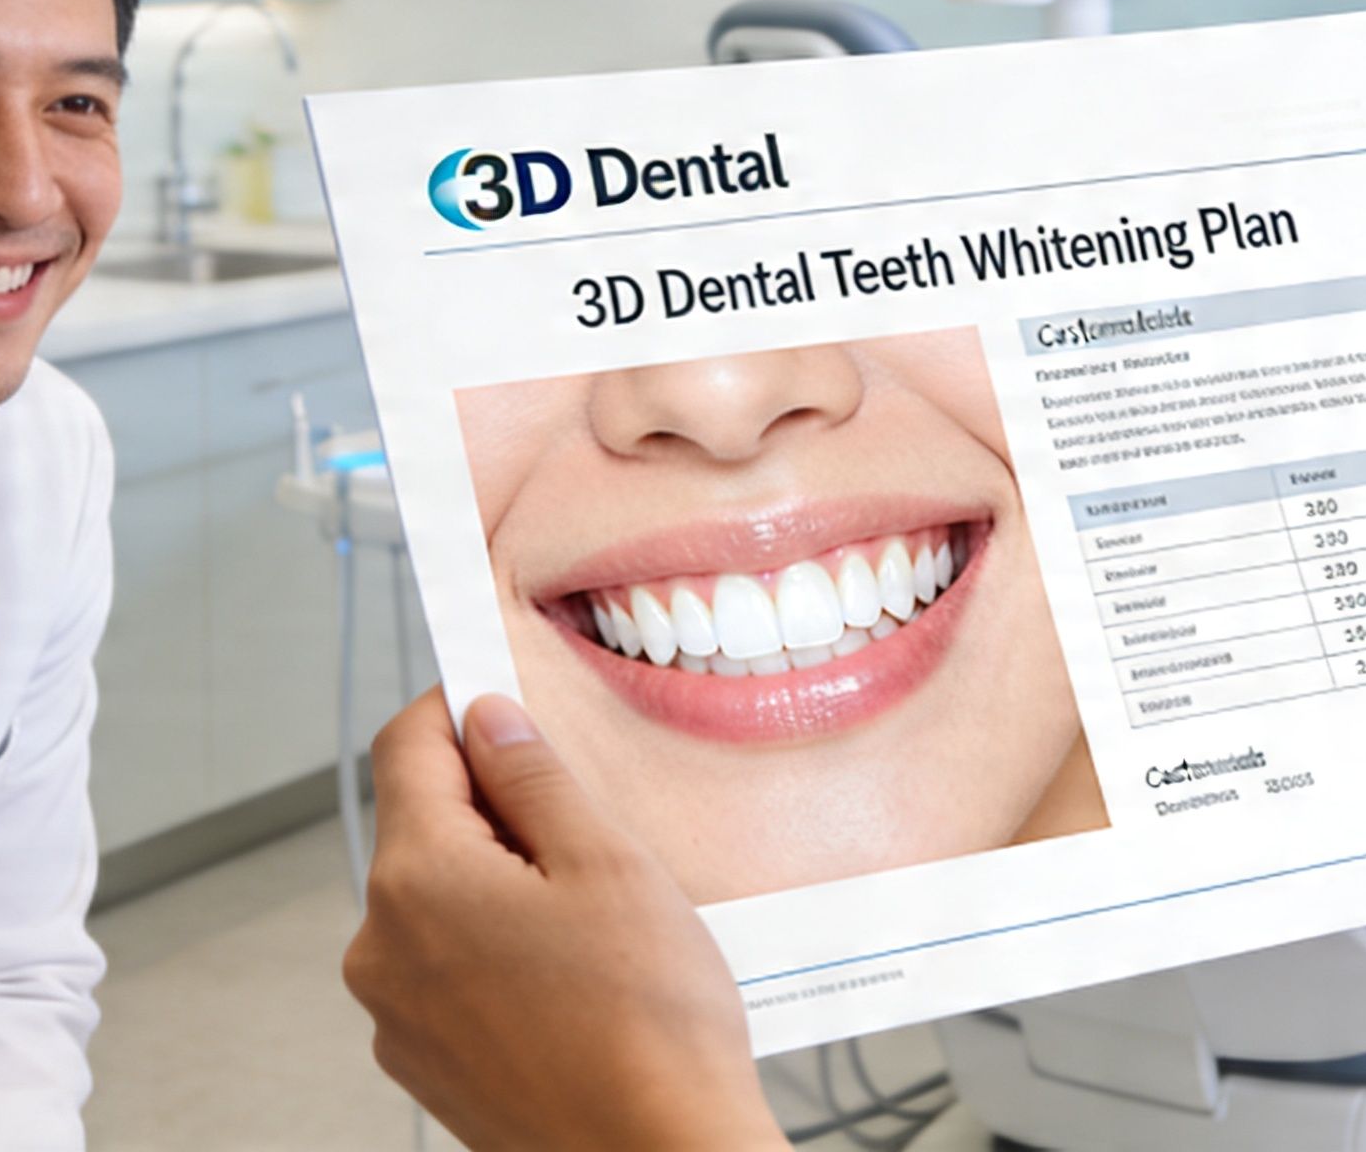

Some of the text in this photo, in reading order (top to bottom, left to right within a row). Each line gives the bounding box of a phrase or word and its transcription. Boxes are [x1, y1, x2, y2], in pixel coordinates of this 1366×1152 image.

[462, 133, 789, 221] 3D Dental
[572, 202, 1299, 327] 3D Dental Teeth Whitening Plan
